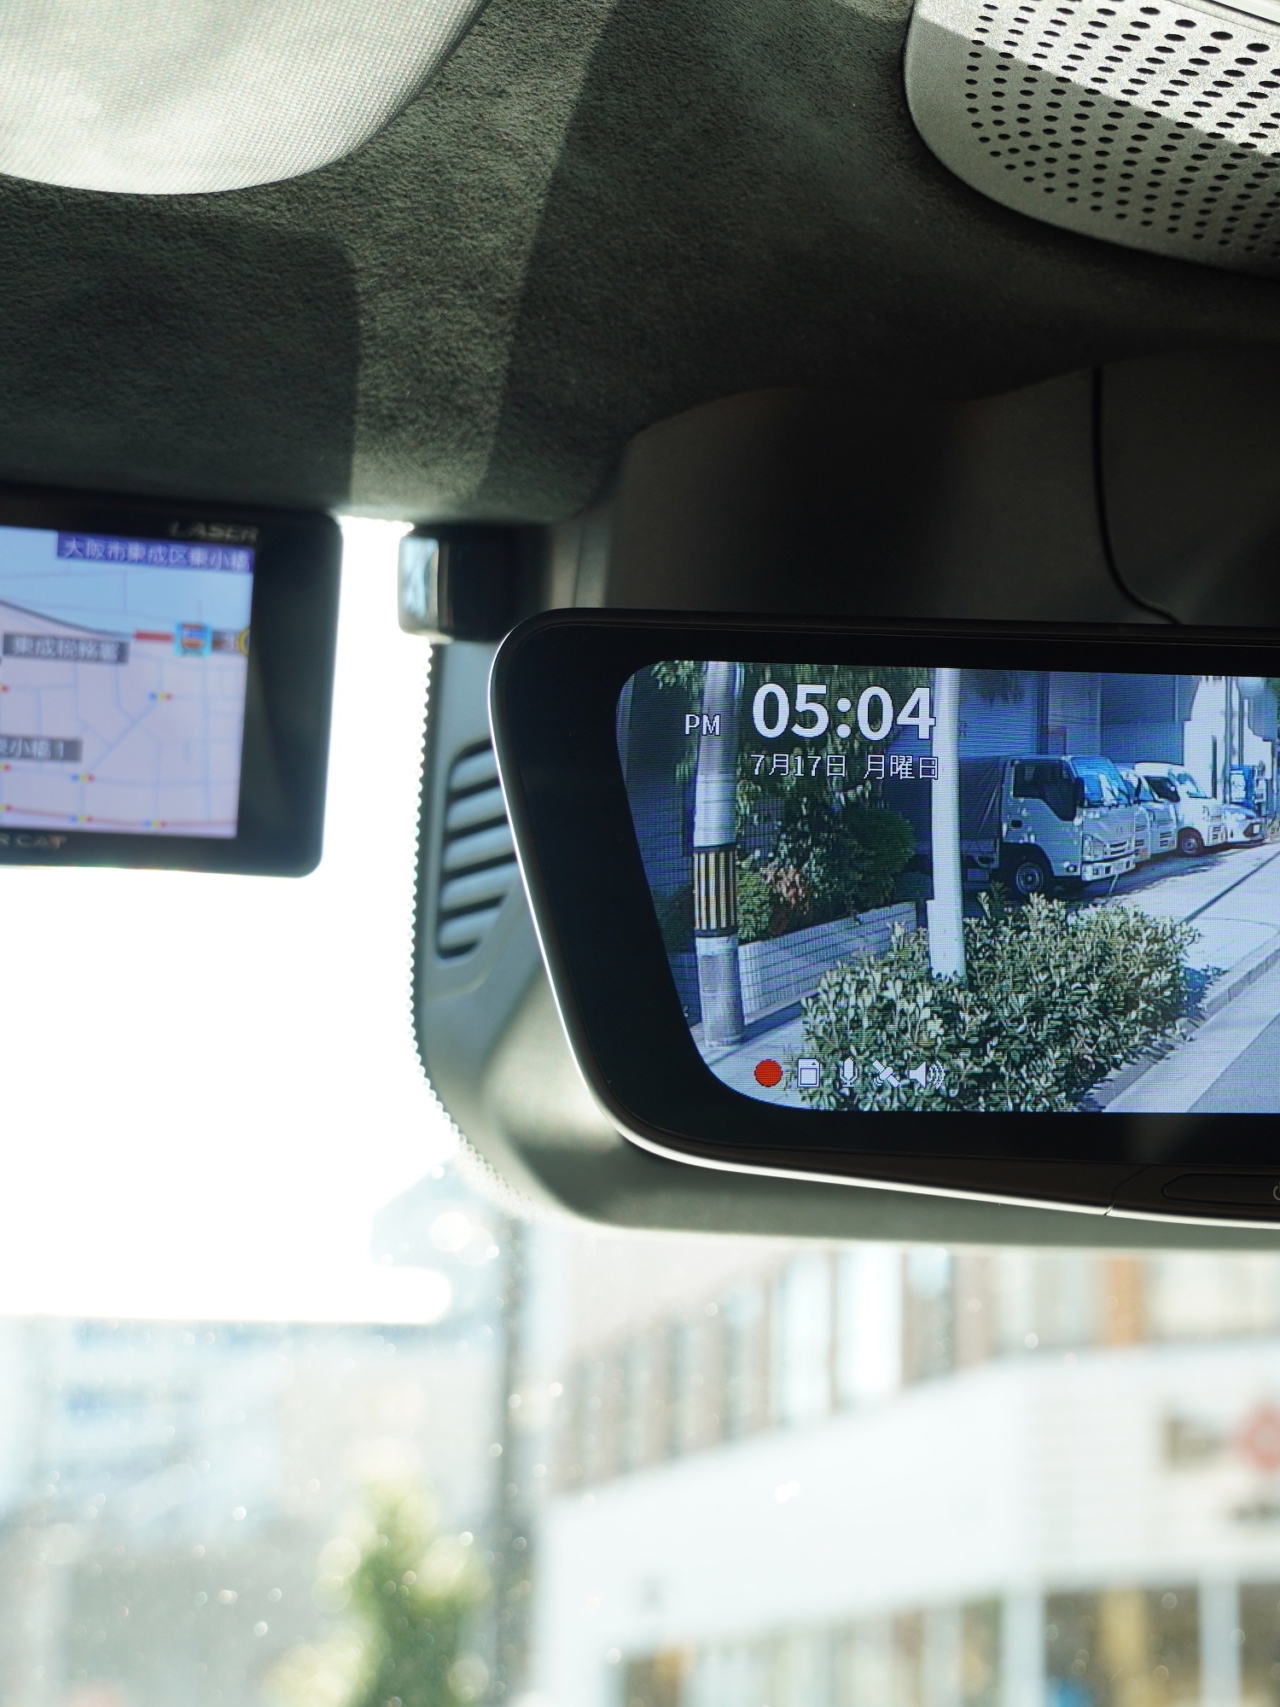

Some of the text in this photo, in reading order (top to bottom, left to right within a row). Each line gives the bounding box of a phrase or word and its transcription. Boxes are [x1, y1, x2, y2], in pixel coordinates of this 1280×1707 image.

[685, 714, 721, 736] PM
[752, 683, 937, 741] 05:04
[750, 754, 940, 780] 7月17日 月曜日
